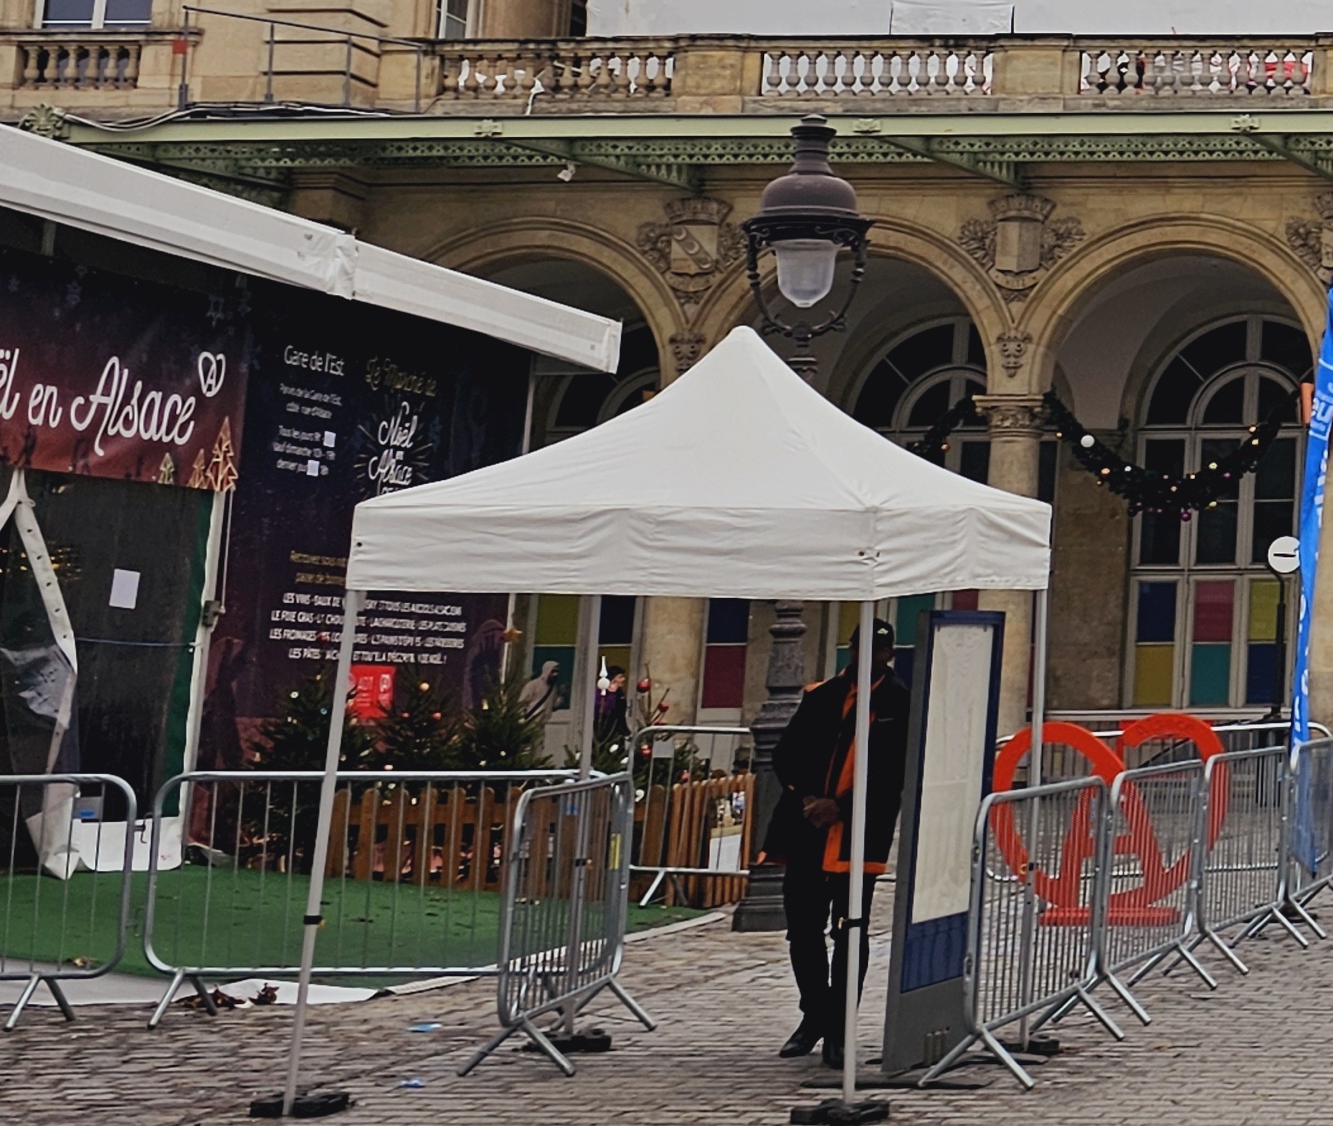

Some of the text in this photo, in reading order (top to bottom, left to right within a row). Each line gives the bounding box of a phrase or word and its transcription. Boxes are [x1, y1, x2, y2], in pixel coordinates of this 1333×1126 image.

[284, 345, 309, 369] Gare
[309, 350, 323, 372] de
[28, 383, 62, 428] en
[70, 356, 196, 456] Alsace
[378, 401, 418, 448] Noël
[368, 448, 413, 496] Alsace
